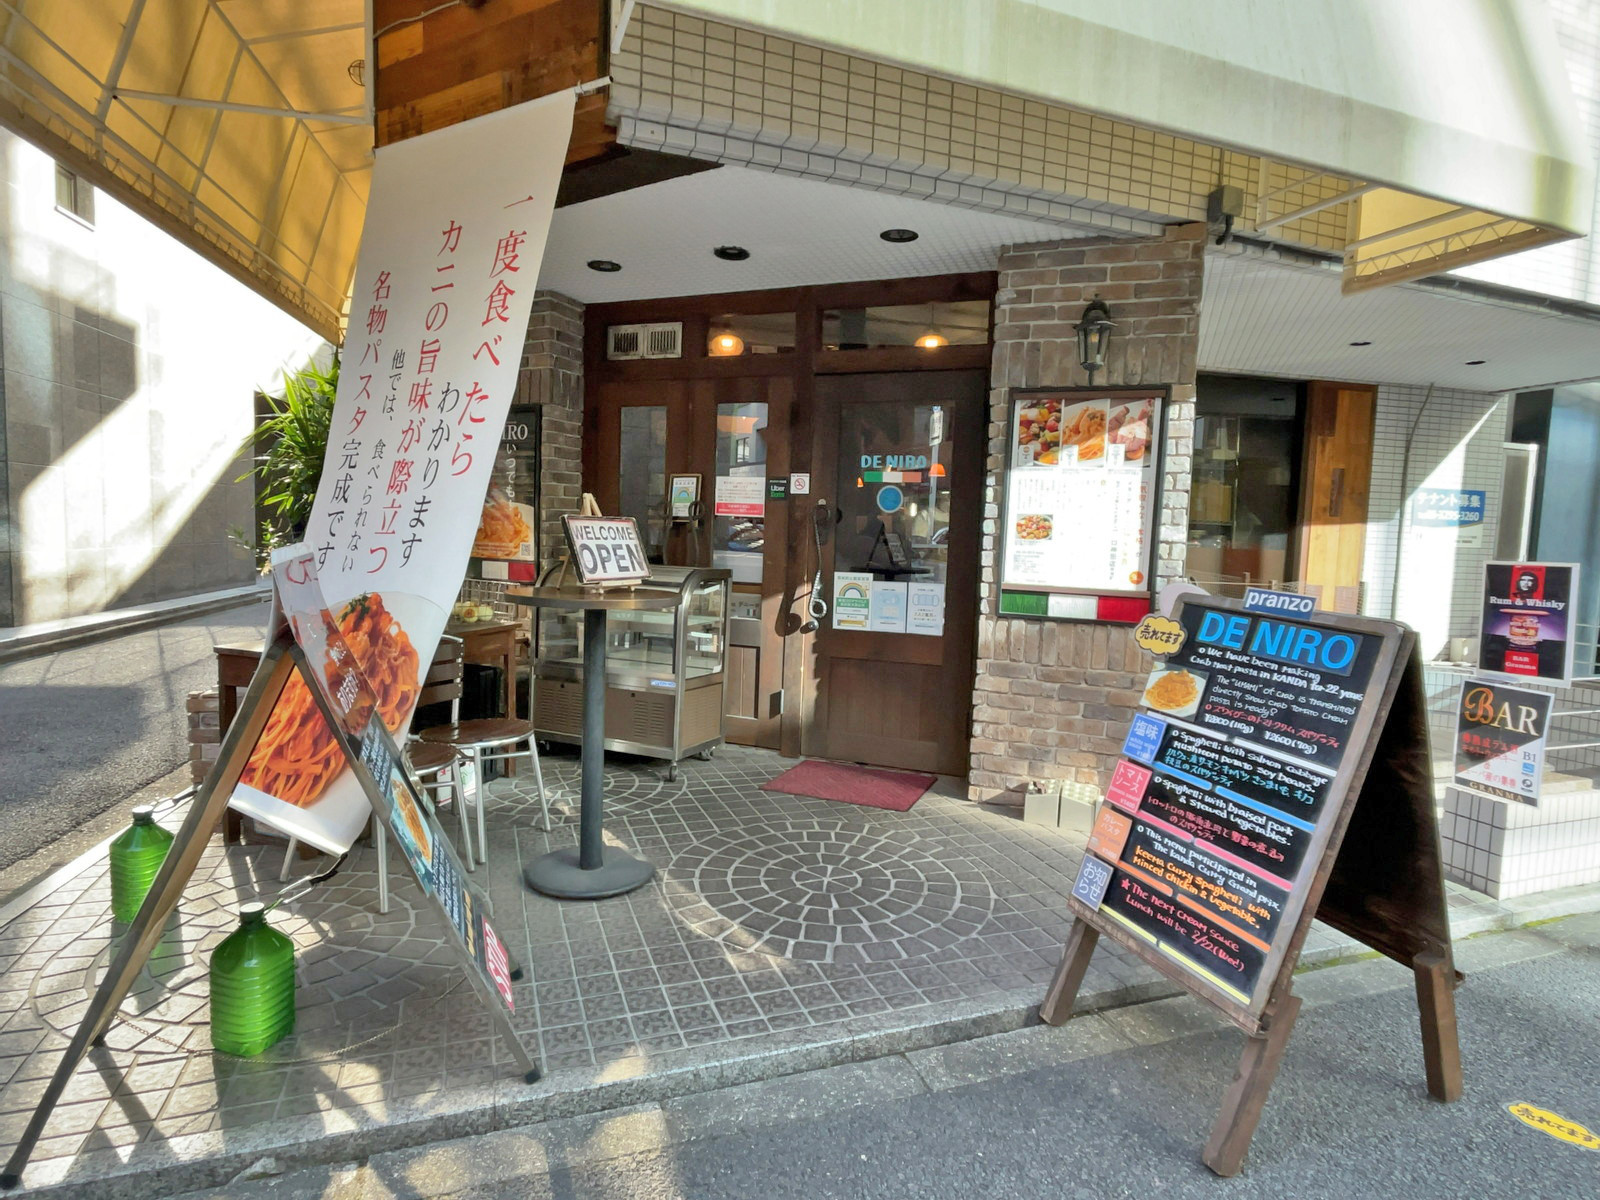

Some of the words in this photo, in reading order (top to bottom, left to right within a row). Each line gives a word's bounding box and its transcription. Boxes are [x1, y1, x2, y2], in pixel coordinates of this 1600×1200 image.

[450, 195, 534, 477] 一度食べたら
[367, 220, 463, 575] カニの旨味が際立つ
[860, 454, 882, 469] DE
[885, 454, 927, 469] NIRO
[399, 381, 461, 569] わかります
[572, 525, 636, 541] WELCOME
[579, 543, 645, 575] OPEN
[1245, 591, 1314, 613] pranzo
[1489, 596, 1513, 605] Rum
[1514, 597, 1524, 606] &
[1526, 598, 1566, 611] Whisky
[1140, 622, 1183, 645] 売れてます
[1197, 612, 1249, 649] DE
[1251, 621, 1356, 669] NIRO
[1207, 647, 1223, 658] We
[1225, 650, 1251, 664] have
[1251, 656, 1279, 671] been
[1234, 663, 1258, 677] pasta
[1260, 670, 1271, 680] in
[1212, 685, 1243, 700] directly
[1263, 688, 1276, 696] of
[1298, 696, 1307, 704] is
[1464, 687, 1540, 737] BAR
[1133, 720, 1159, 741] 塩味
[1222, 744, 1246, 758] with
[1115, 775, 1140, 793] ソース
[1118, 765, 1144, 782] トマト
[1468, 781, 1524, 803] GRANMA
[1103, 813, 1124, 828] カレー
[1203, 794, 1227, 809] with
[1228, 803, 1267, 826] braised
[1267, 820, 1295, 837] pork
[1100, 822, 1121, 836] パスタ
[1145, 827, 1163, 842] This
[1188, 849, 1245, 882] participated
[1245, 876, 1257, 888] in
[1152, 841, 1169, 855] The
[1131, 883, 1149, 900] The
[1151, 895, 1176, 915] next
[1247, 902, 1271, 921] with
[1156, 912, 1174, 929] will
[1174, 922, 1188, 936] be
